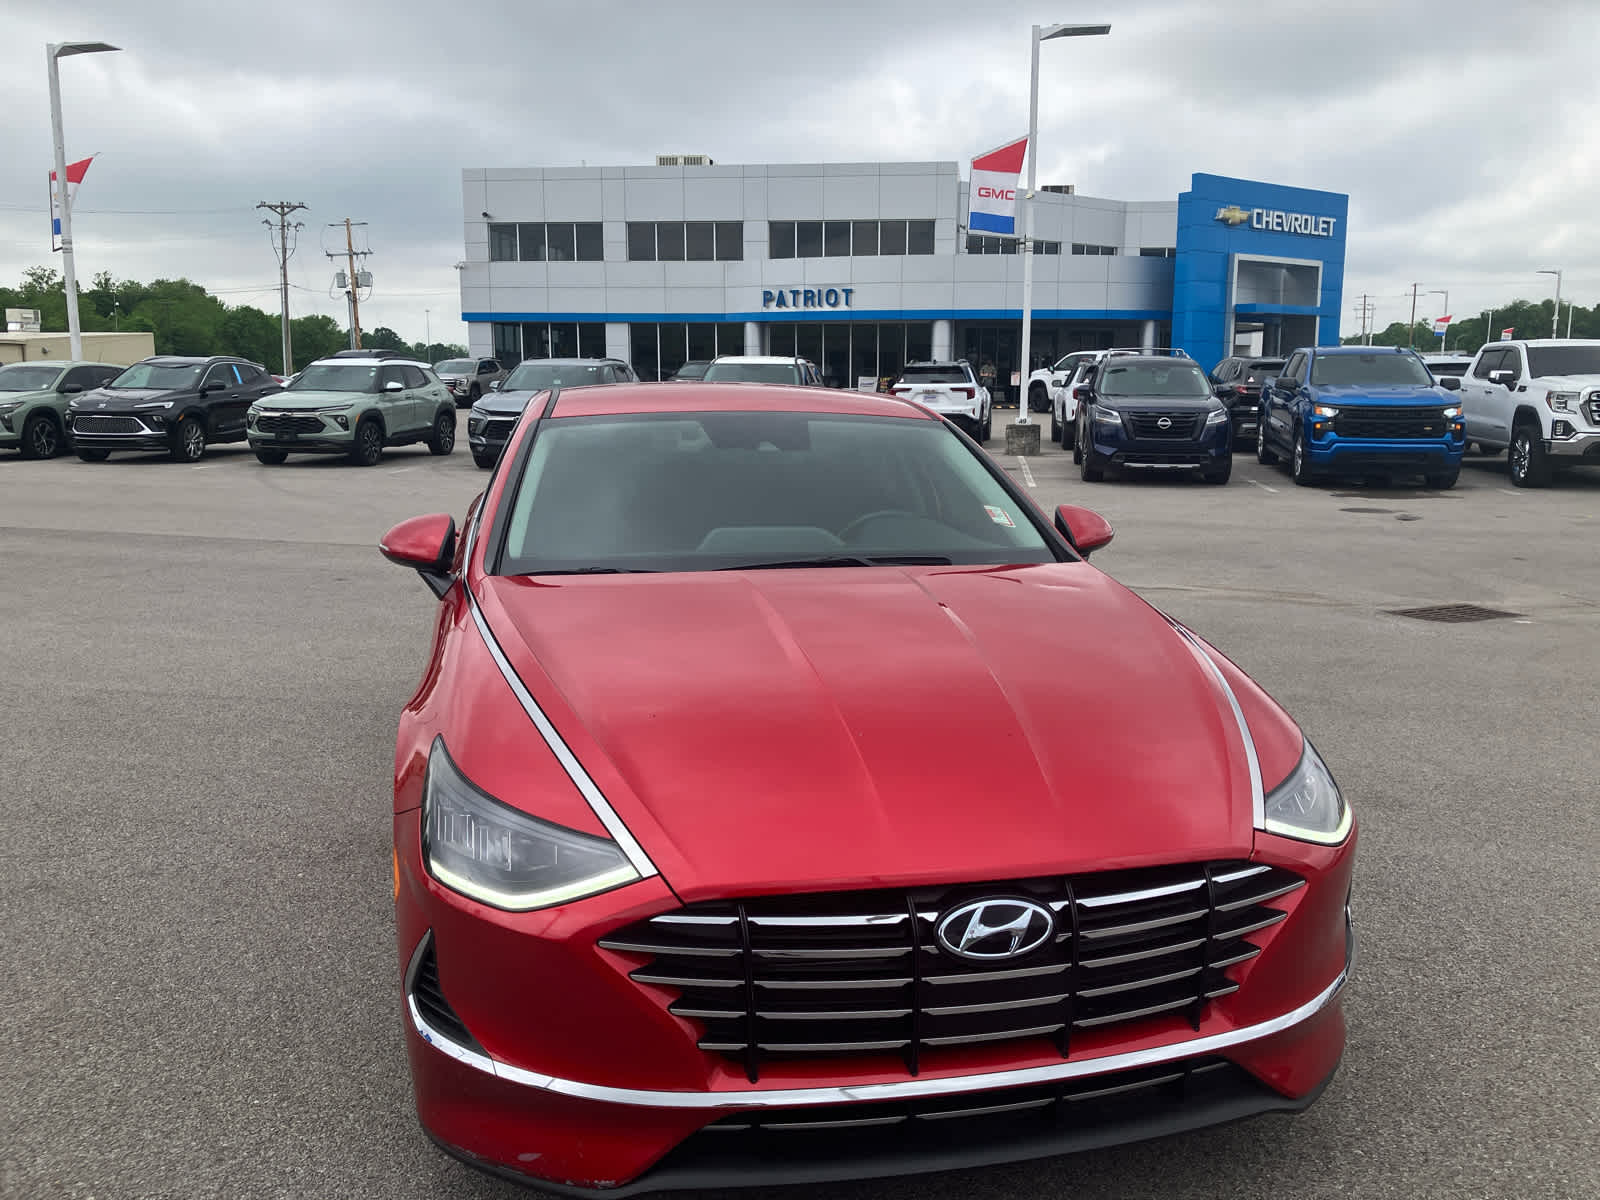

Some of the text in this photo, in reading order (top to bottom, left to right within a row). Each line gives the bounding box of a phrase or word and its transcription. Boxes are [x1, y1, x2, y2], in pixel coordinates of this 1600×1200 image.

[978, 186, 1015, 201] GMC
[1252, 208, 1336, 237] CHEVROLET
[762, 288, 854, 308] PATRIOT
